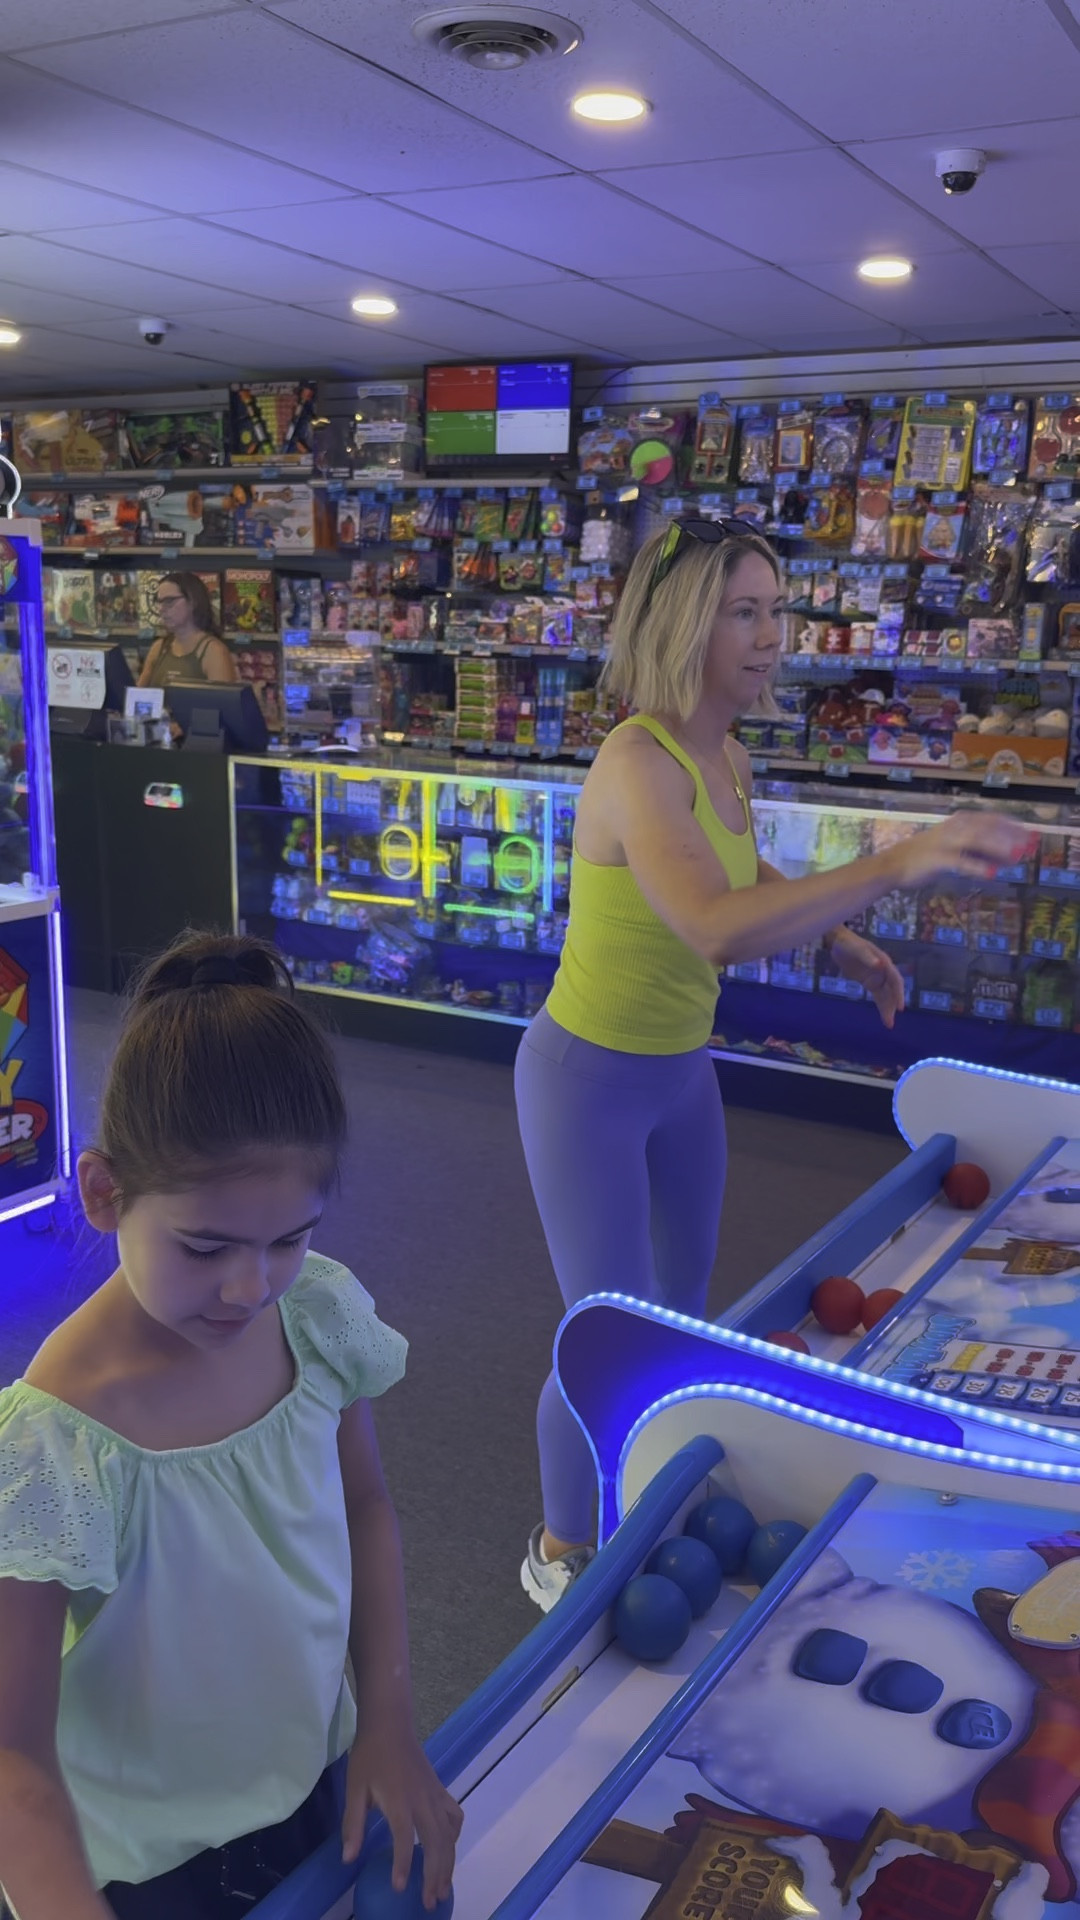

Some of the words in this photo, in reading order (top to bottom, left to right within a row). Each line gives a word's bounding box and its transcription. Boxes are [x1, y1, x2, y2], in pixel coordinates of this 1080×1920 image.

[227, 571, 270, 581] MONOPOLY
[966, 1381, 985, 1392] 30
[999, 1384, 1017, 1396] 28
[1031, 1388, 1050, 1399] 26
[973, 1703, 995, 1739] ICE
[683, 1841, 746, 1920] SCORE
[722, 1858, 780, 1920] YOUR
